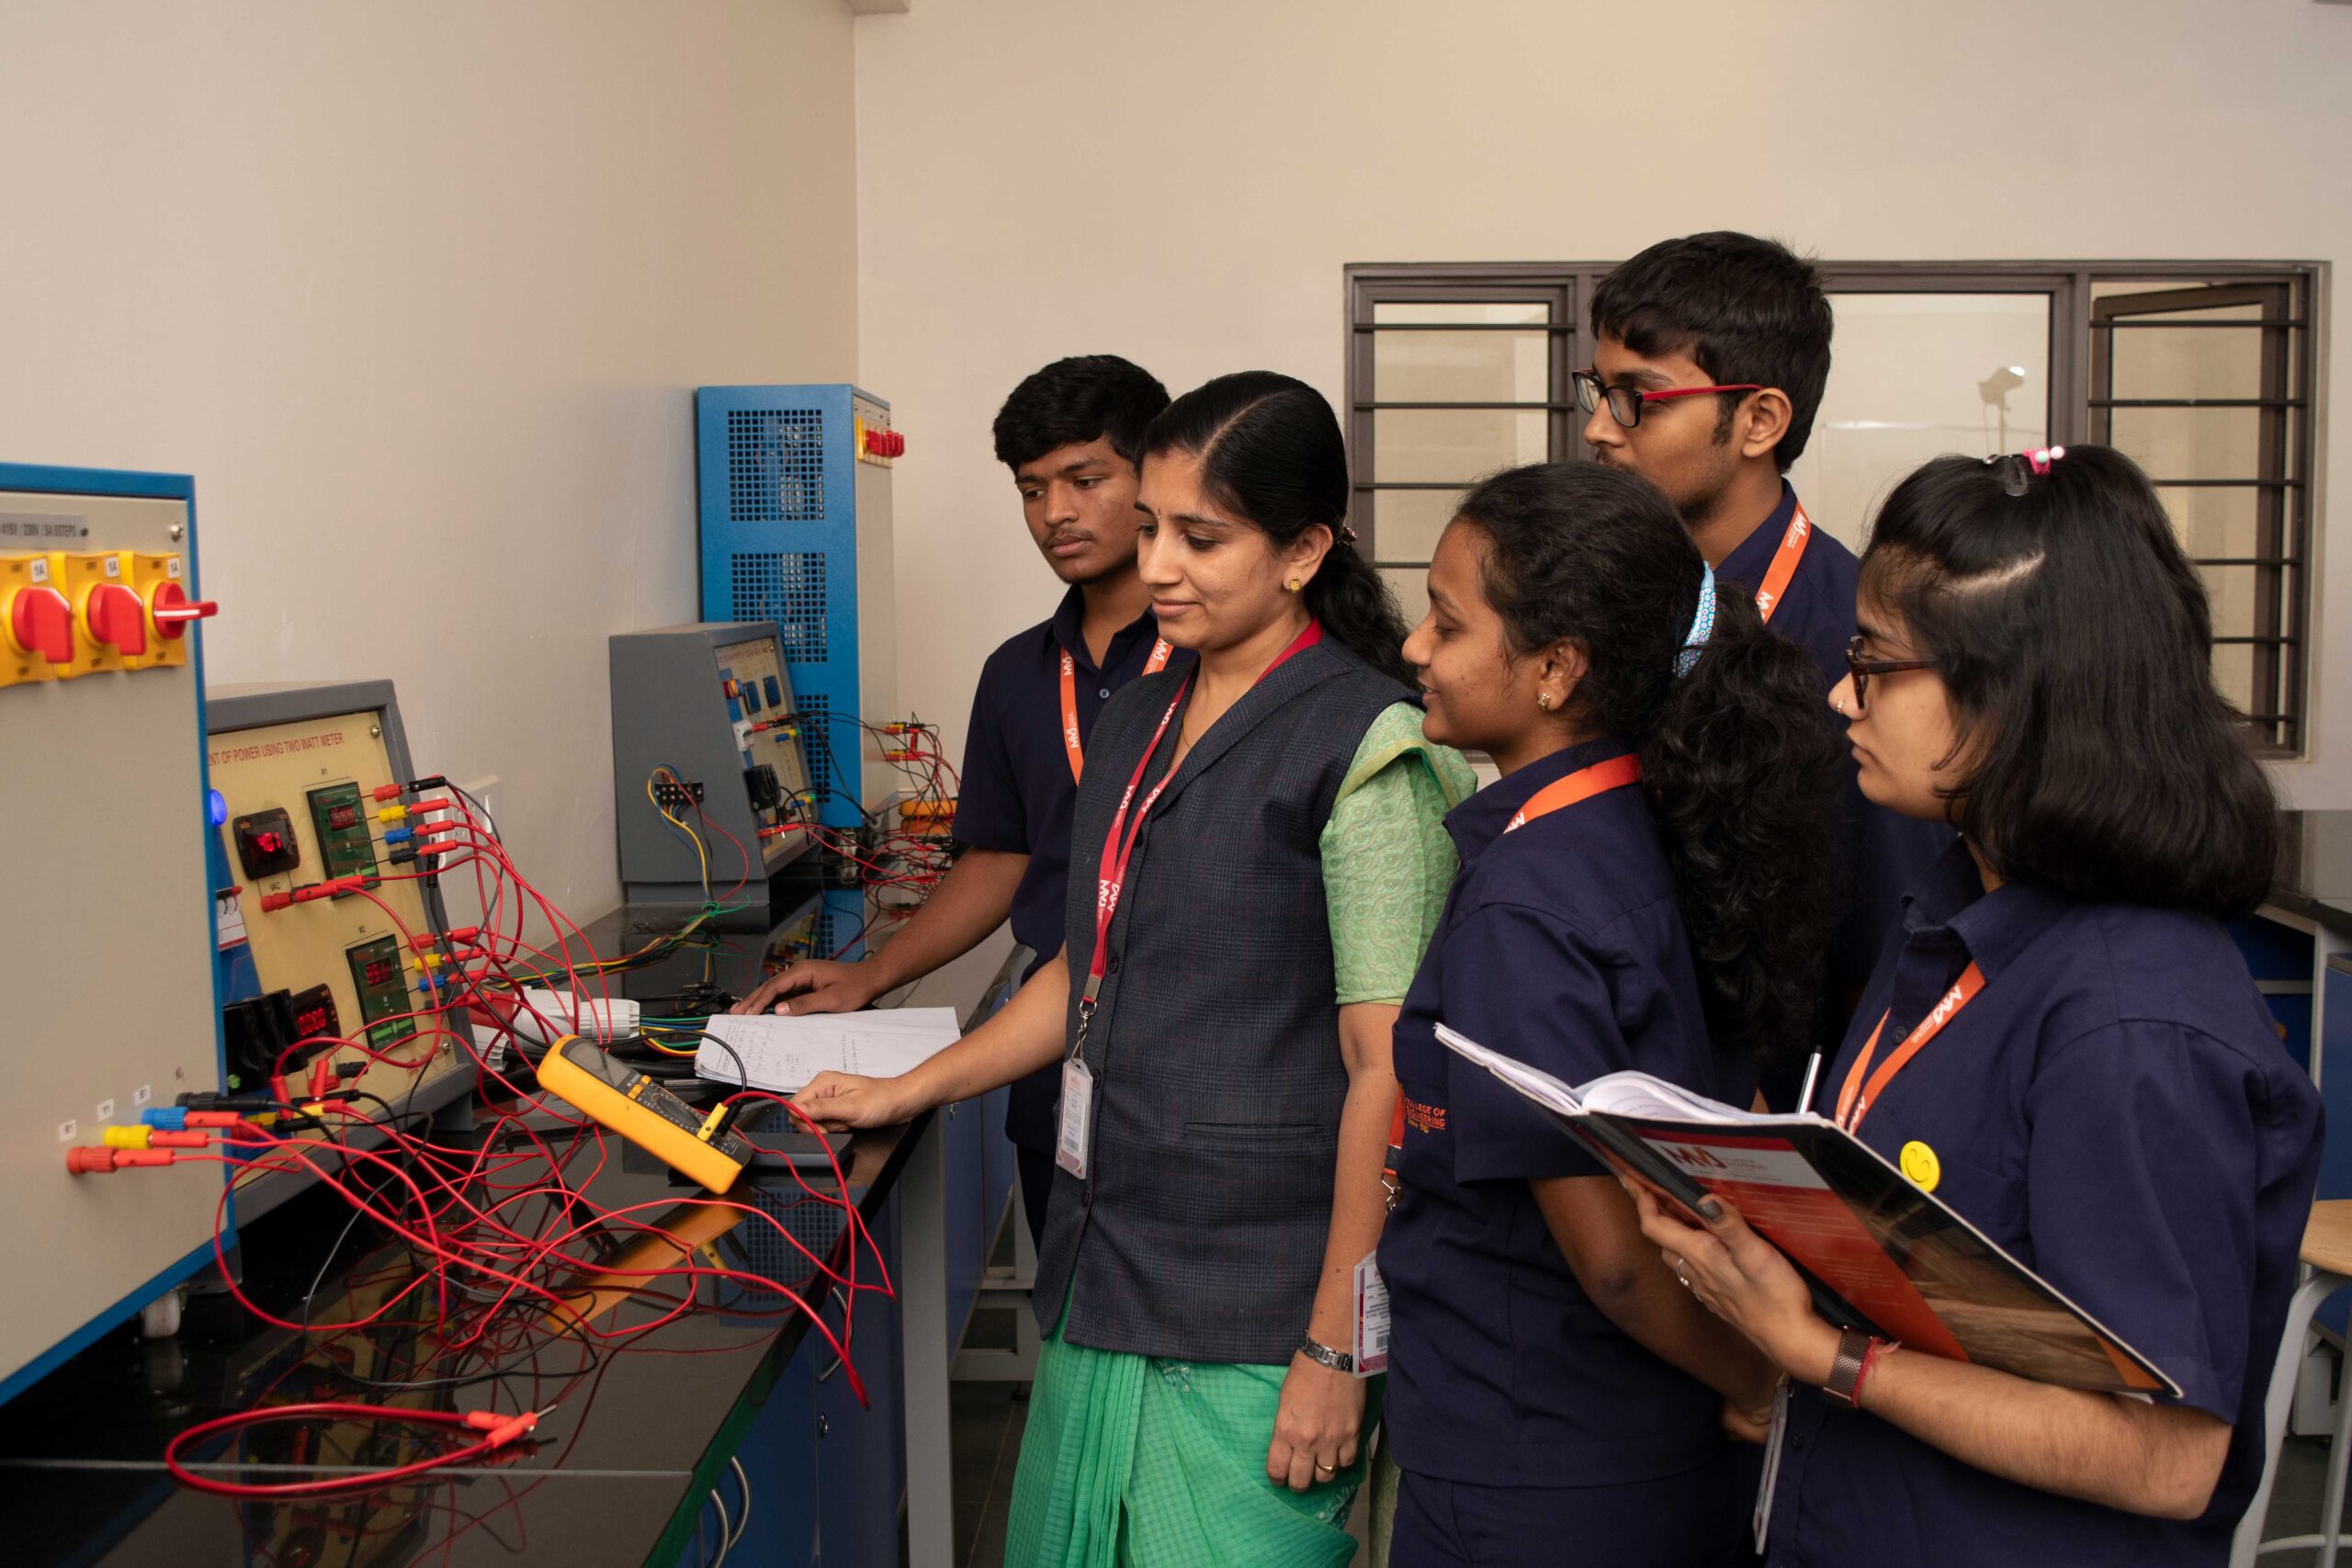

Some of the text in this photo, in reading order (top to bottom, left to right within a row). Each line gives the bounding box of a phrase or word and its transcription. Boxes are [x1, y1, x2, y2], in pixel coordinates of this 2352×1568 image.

[34, 564, 45, 577] 1A
[108, 561, 118, 573] 1A
[170, 562, 178, 573] 1A
[221, 750, 232, 764] OF
[233, 746, 261, 761] POWER
[260, 742, 286, 757] USING
[284, 739, 301, 753] TWO
[300, 736, 321, 750] WATT
[321, 732, 345, 747] METER
[269, 881, 281, 892] VAC
[1432, 1107, 1447, 1117] OF
